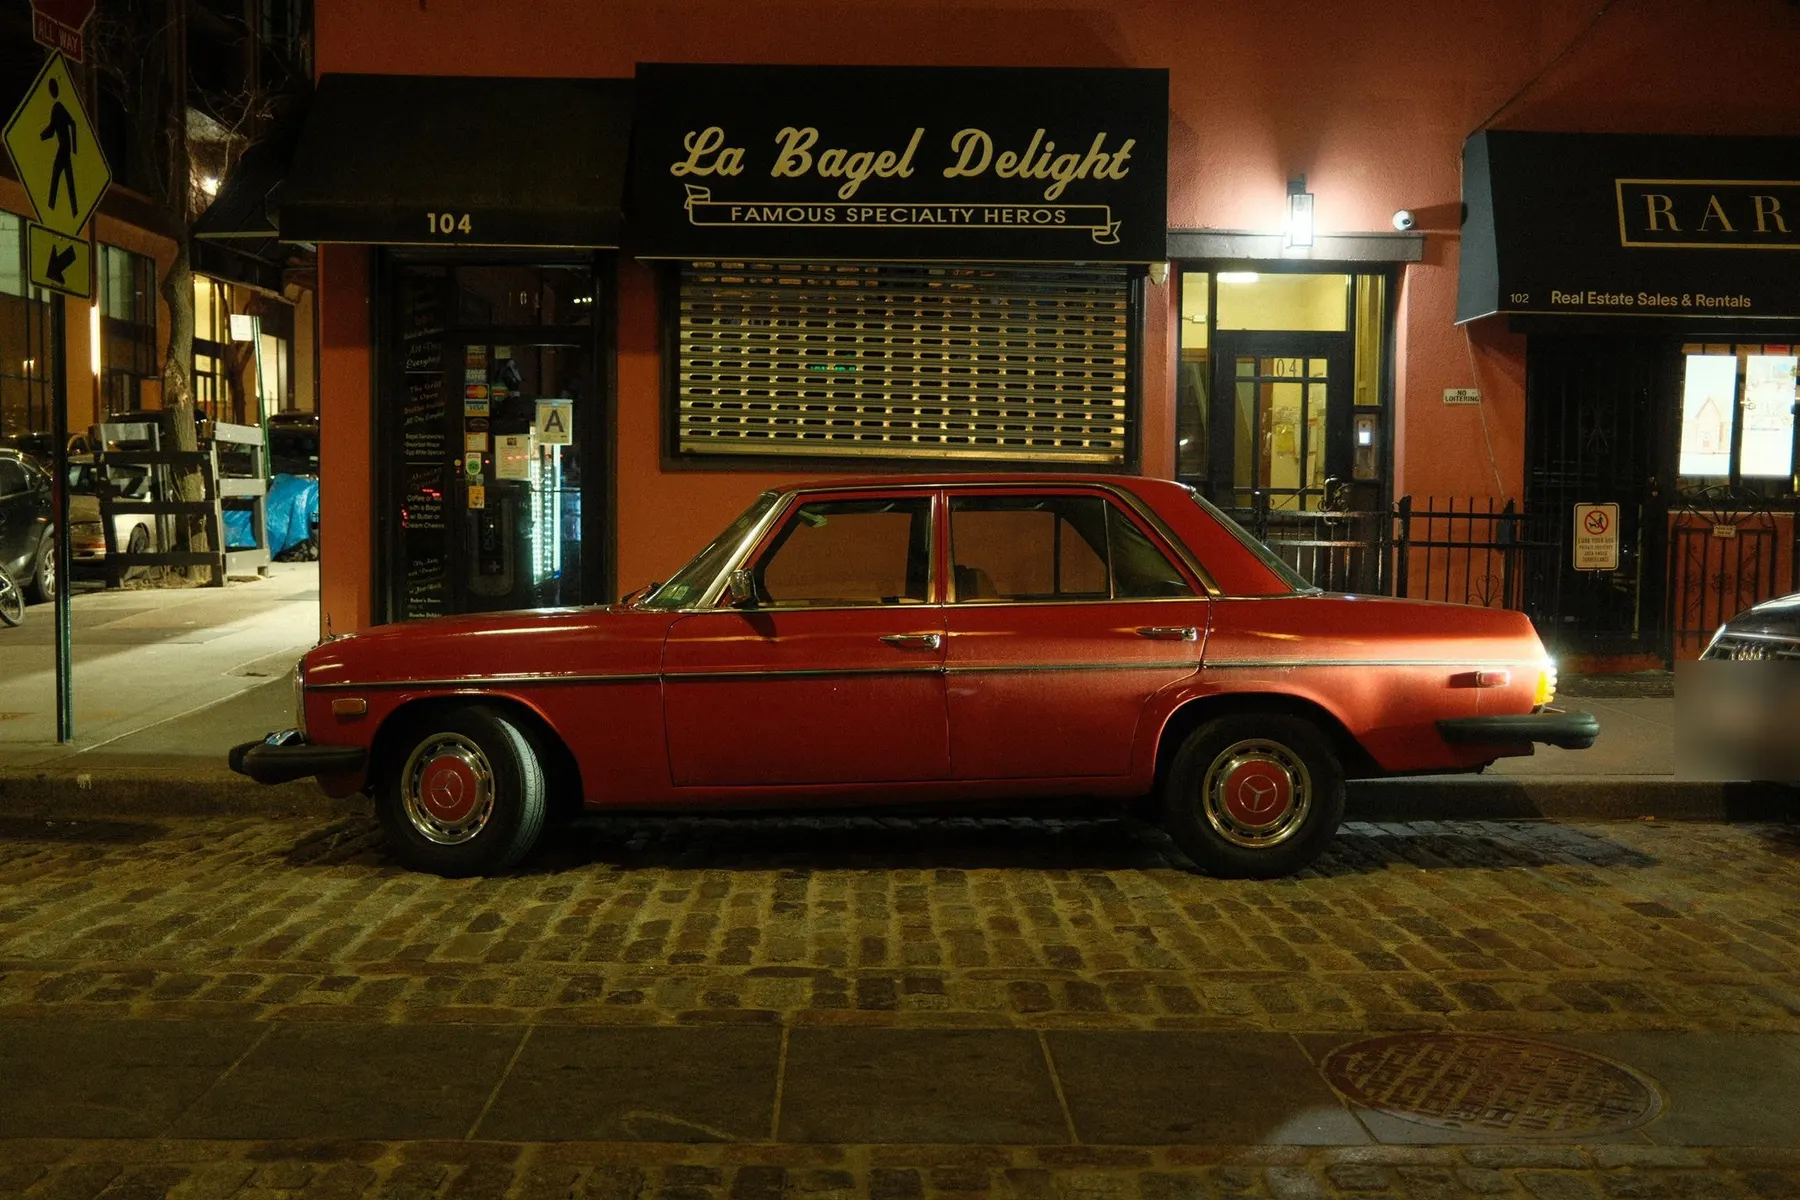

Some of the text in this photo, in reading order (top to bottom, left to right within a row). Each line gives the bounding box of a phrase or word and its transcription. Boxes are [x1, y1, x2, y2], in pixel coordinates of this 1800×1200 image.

[38, 20, 79, 53] ALL WAY
[671, 127, 1136, 201] La Bagel Delight
[427, 212, 472, 234] 104
[731, 207, 1066, 224] FAMOUS SPECIALTY HEROS
[1510, 293, 1529, 303] 102
[1551, 290, 1752, 308] Real Estate Sales & Rentals
[544, 409, 565, 433] A
